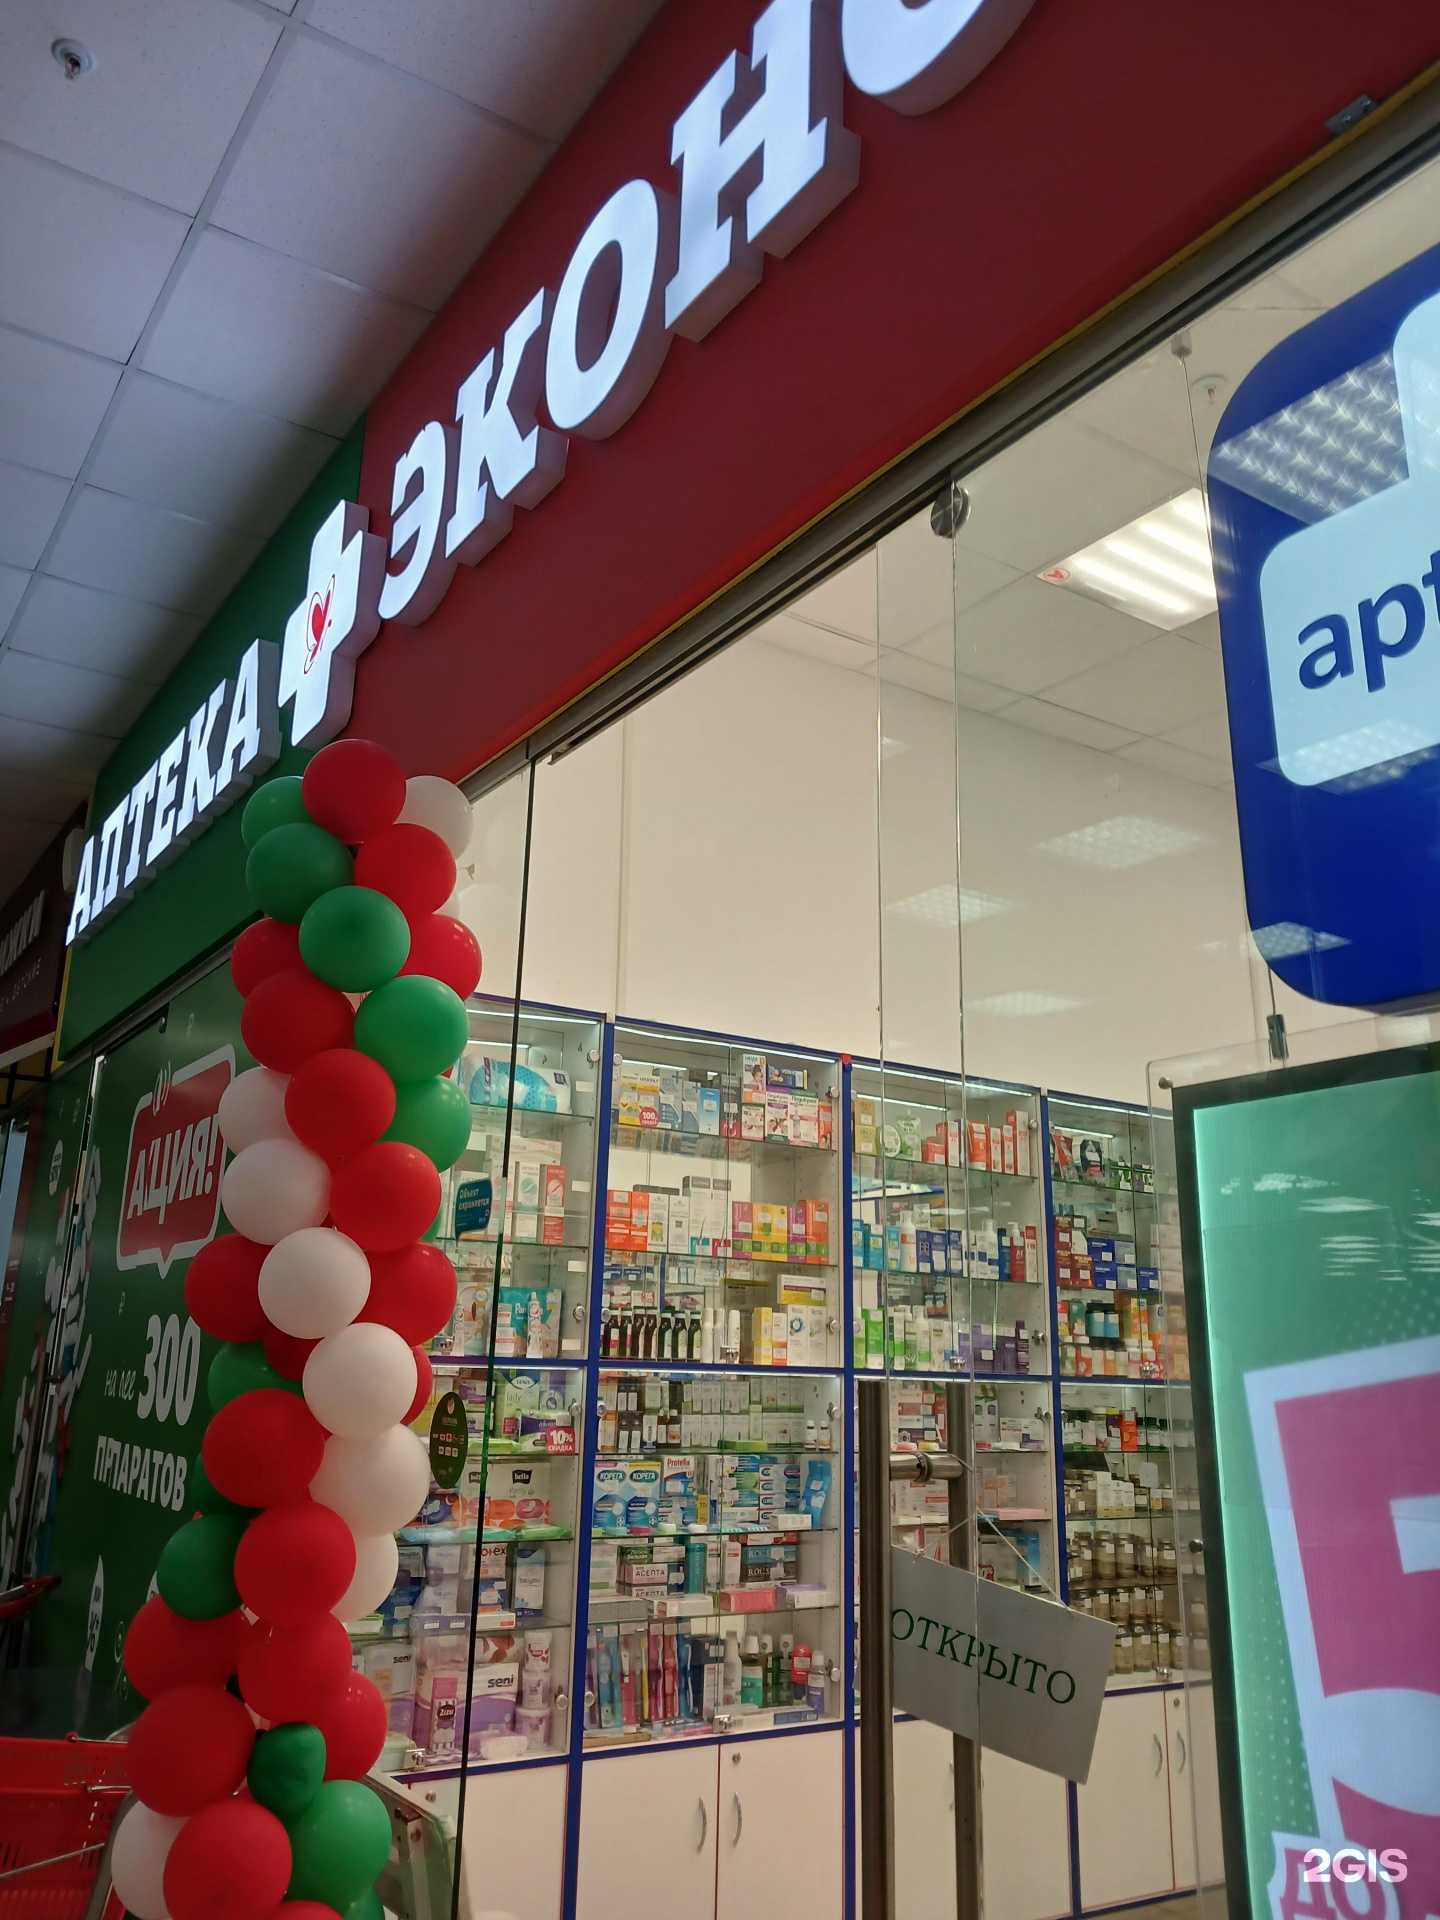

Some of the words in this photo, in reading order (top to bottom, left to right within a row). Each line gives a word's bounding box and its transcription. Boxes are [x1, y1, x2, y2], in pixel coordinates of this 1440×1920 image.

[66, 638, 262, 946] АПТЕКА
[127, 1115, 218, 1225] АЦИЯ!
[137, 1313, 201, 1426] 300
[93, 1434, 188, 1513] ПРПАРАТОВ
[600, 1472, 624, 1481] КОРЕГА
[632, 1472, 656, 1480] КОРЕГА
[487, 1674, 514, 1688] seni
[892, 1608, 1076, 1704] ОТКРЫТО
